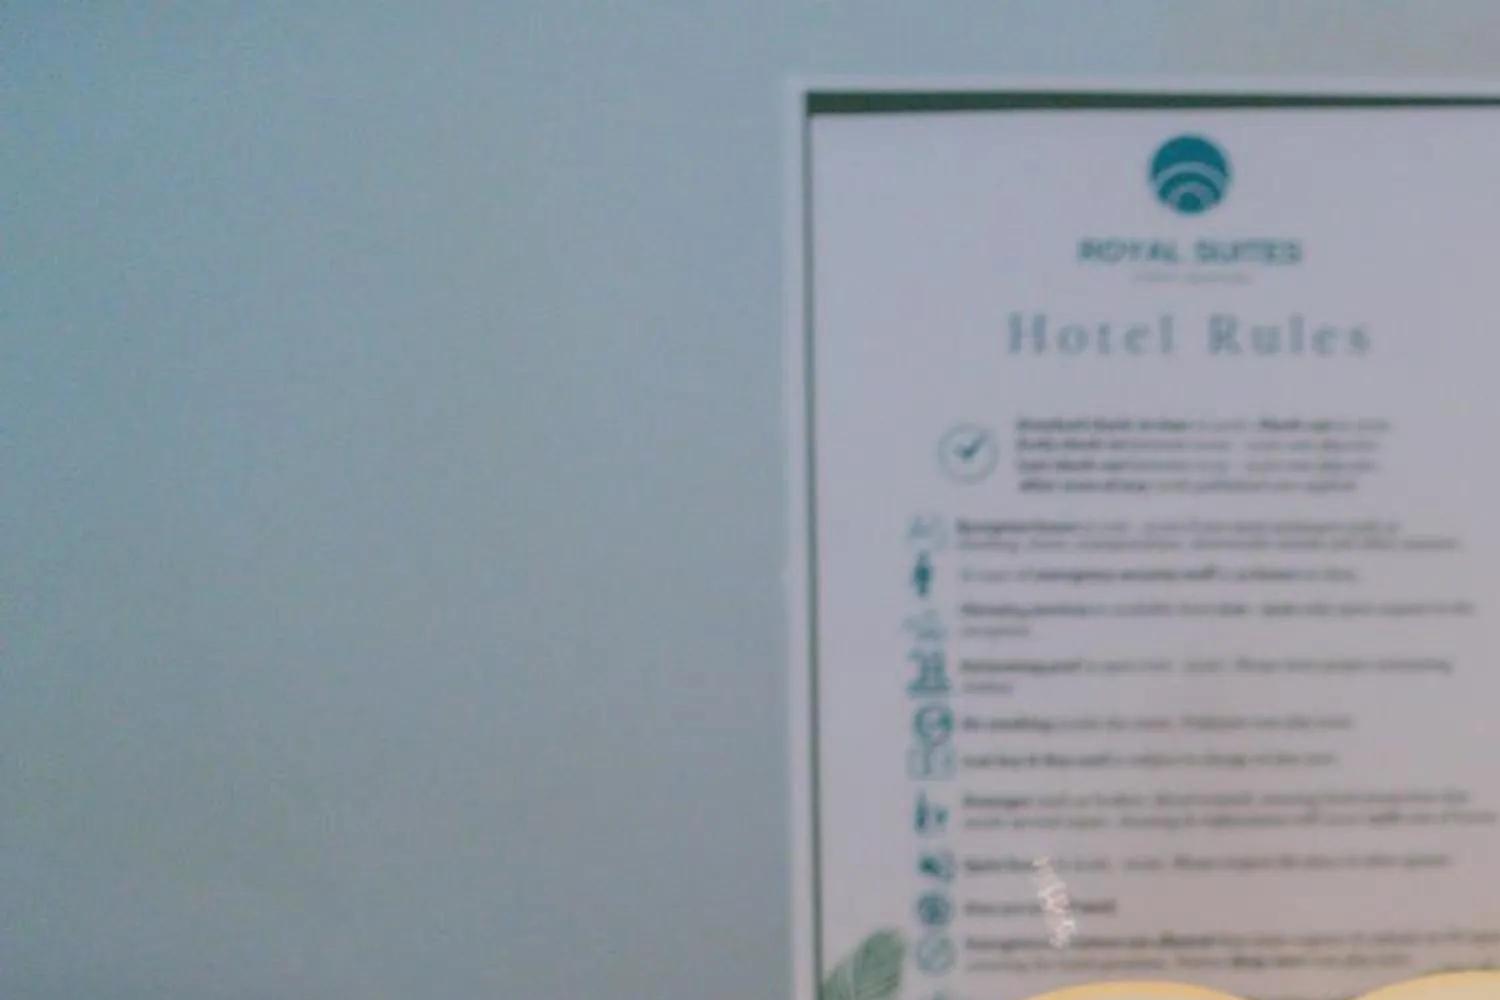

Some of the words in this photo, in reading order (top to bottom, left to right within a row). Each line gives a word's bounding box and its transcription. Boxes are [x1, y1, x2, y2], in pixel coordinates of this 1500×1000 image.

[1076, 237, 1180, 264] ROYAL
[1194, 237, 1303, 264] SUITES
[1007, 312, 1175, 355] Hotel
[1208, 312, 1373, 355] Rules
